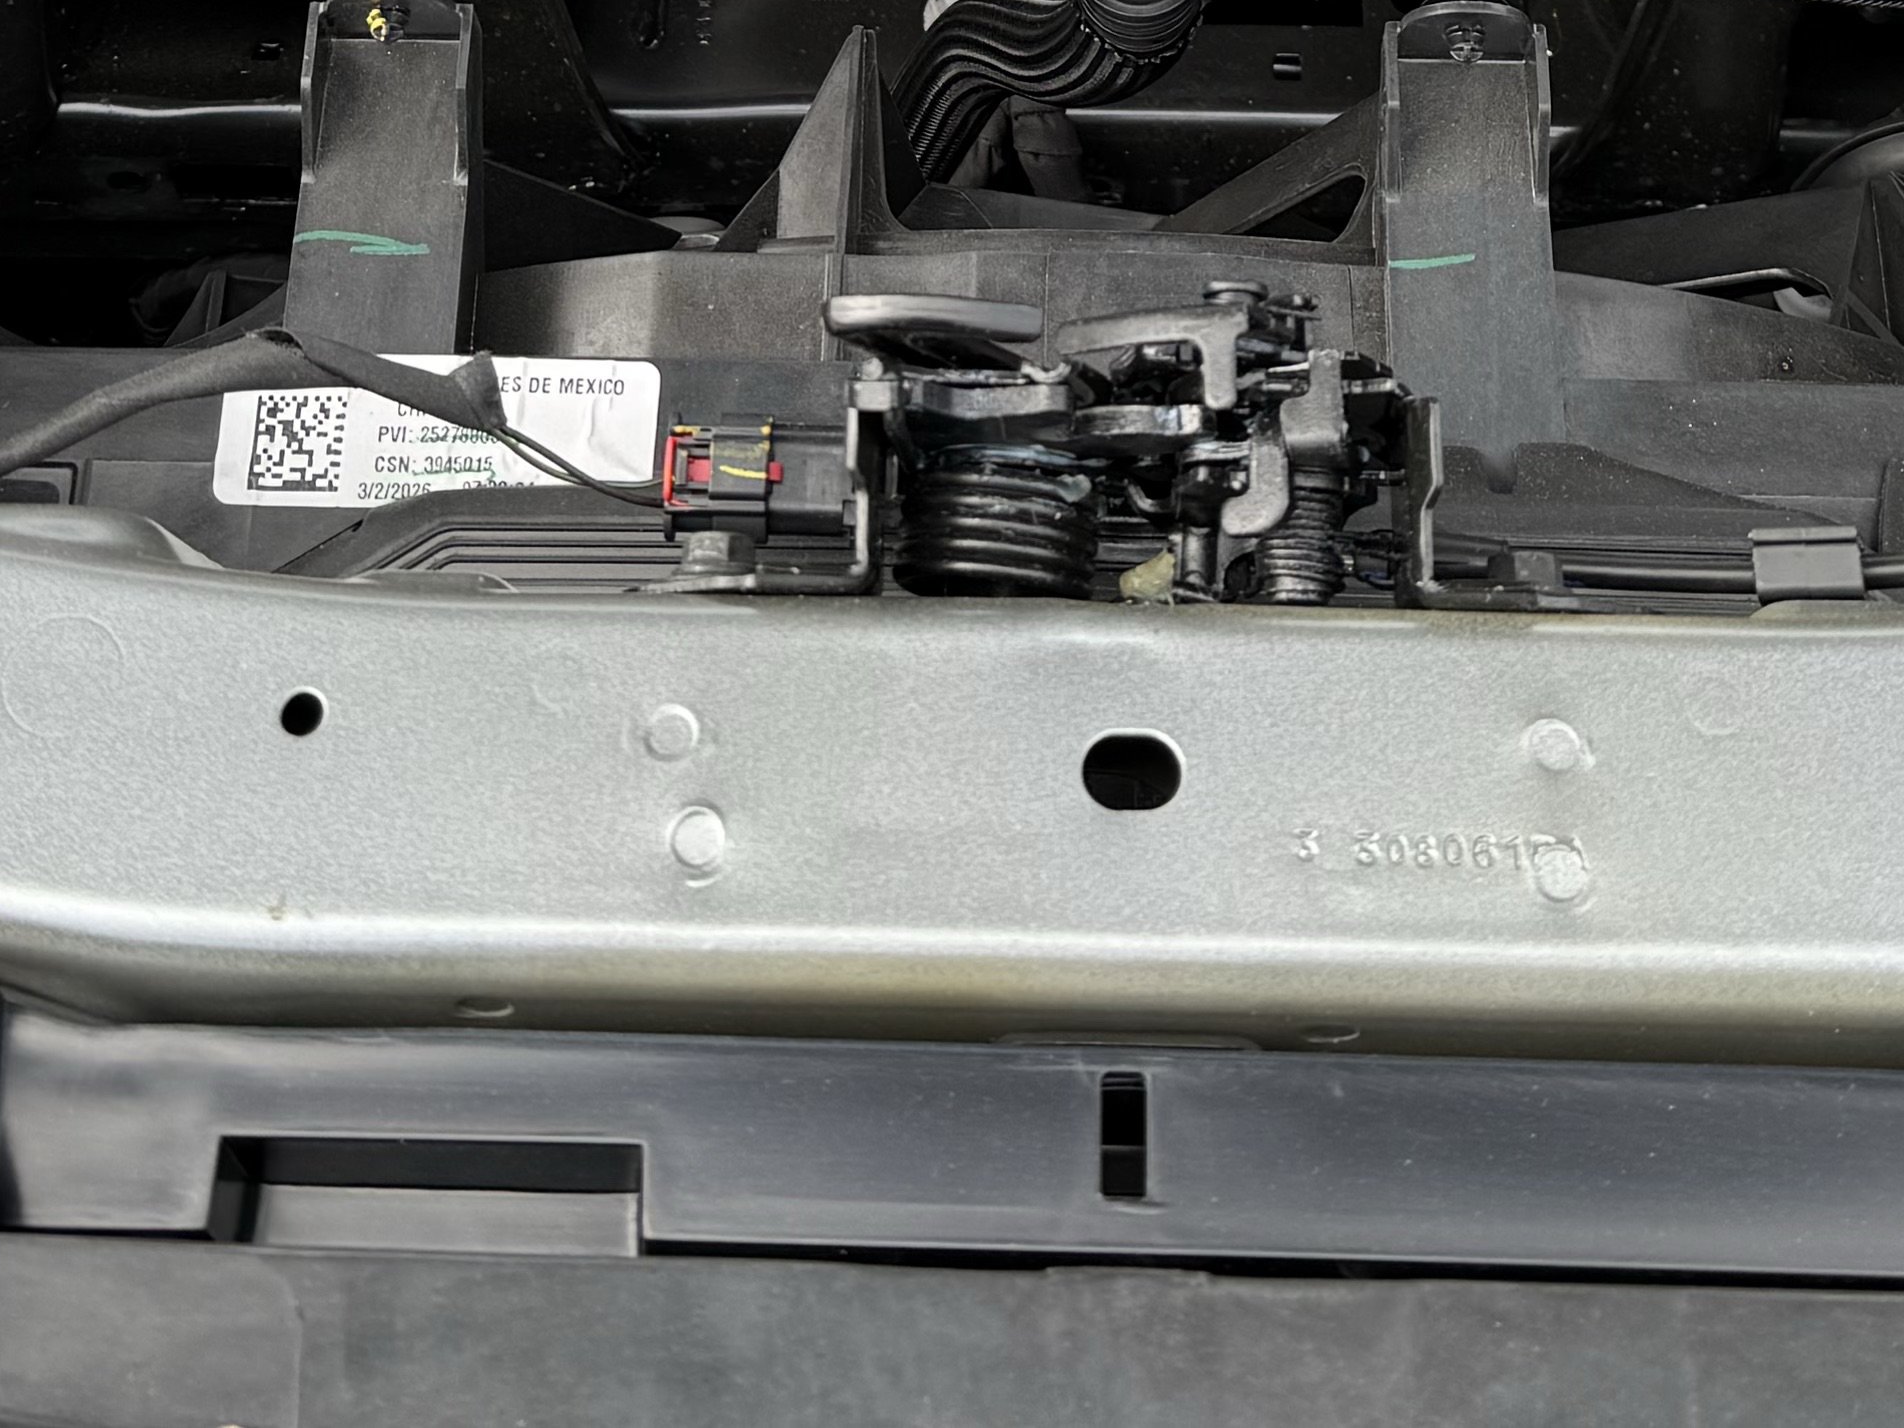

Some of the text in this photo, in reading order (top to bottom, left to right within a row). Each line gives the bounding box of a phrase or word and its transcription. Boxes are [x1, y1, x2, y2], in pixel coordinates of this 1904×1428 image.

[528, 376, 552, 393] DE
[557, 377, 624, 396] MEXICO
[377, 426, 413, 444] PVI:
[374, 455, 493, 473] CSN: 3945015
